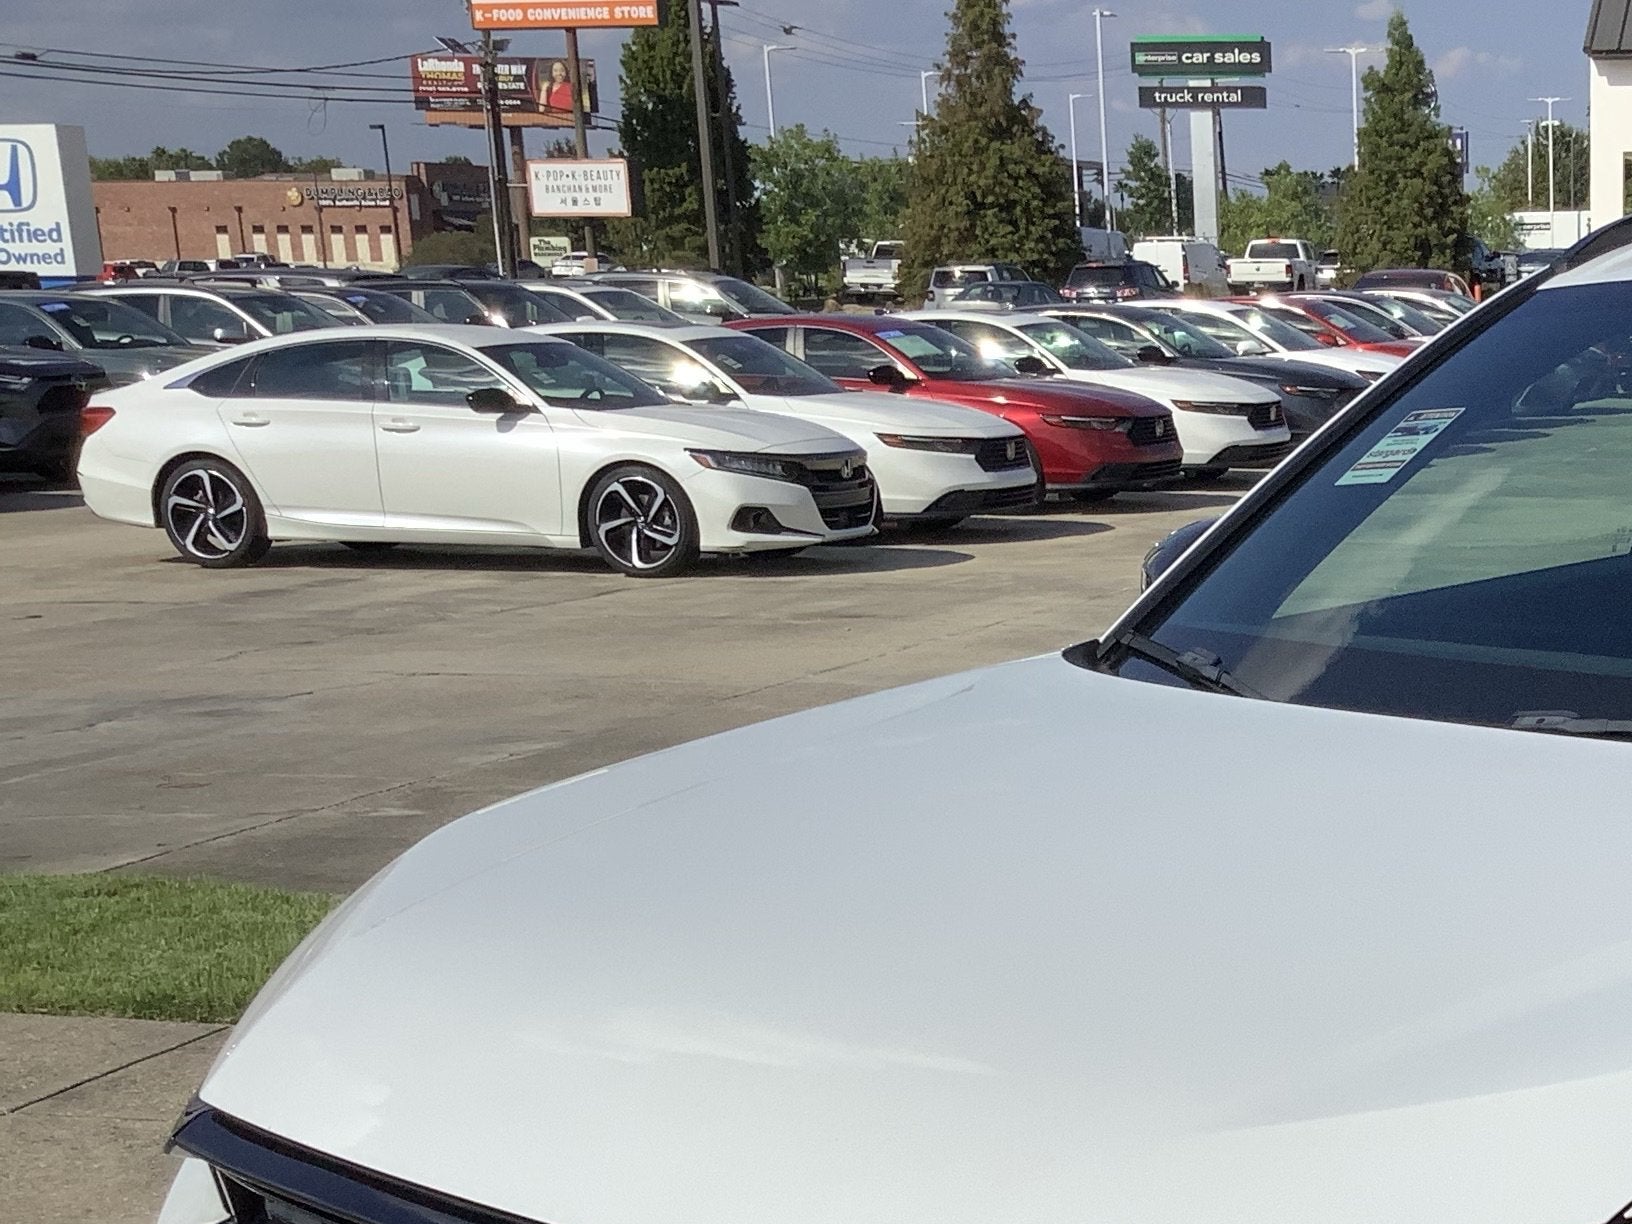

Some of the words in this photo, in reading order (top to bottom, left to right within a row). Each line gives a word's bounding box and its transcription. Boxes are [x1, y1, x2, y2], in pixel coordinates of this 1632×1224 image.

[475, 9, 523, 21] K-FOOD
[527, 7, 610, 21] CONVENIENCE
[614, 6, 654, 19] STORE
[1181, 52, 1211, 64] car
[1214, 48, 1261, 64] sales
[420, 72, 465, 81] THOMAS
[1154, 89, 1193, 103] truck
[1198, 89, 1242, 103] rental
[304, 187, 364, 198] DUMPLING
[591, 184, 614, 193] MORE
